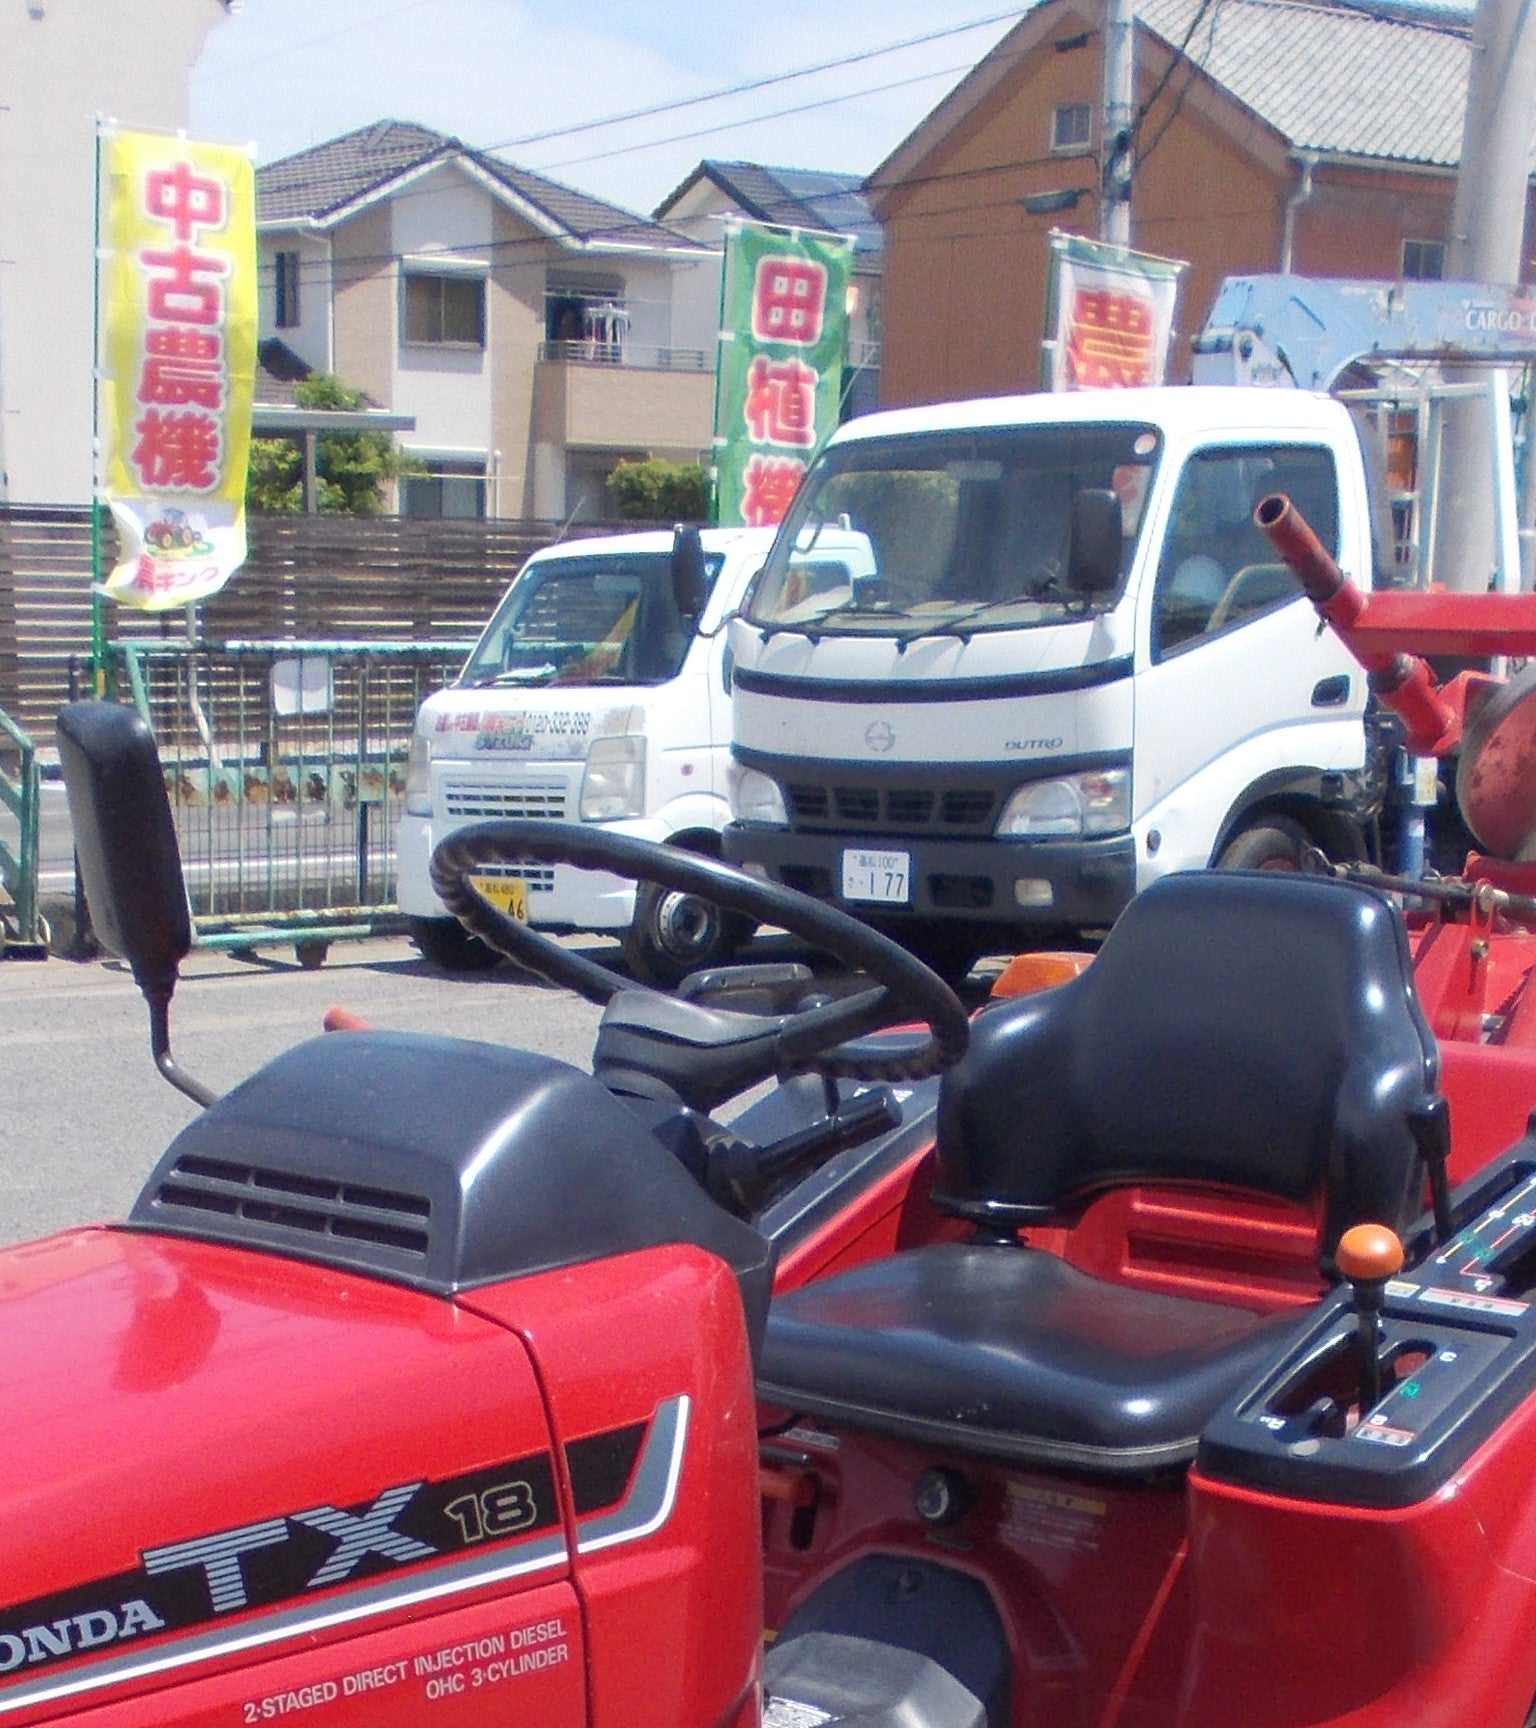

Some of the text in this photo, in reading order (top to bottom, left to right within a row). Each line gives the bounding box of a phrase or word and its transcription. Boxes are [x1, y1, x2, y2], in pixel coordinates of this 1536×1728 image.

[130, 160, 228, 490] 中古農機
[1465, 309, 1522, 331] CARGO
[144, 1480, 537, 1614] TX 18
[343, 1661, 409, 1695] DIRECT
[414, 1634, 506, 1676] INJECTION
[509, 1618, 568, 1650] DIESEL
[425, 1672, 465, 1701] OHC
